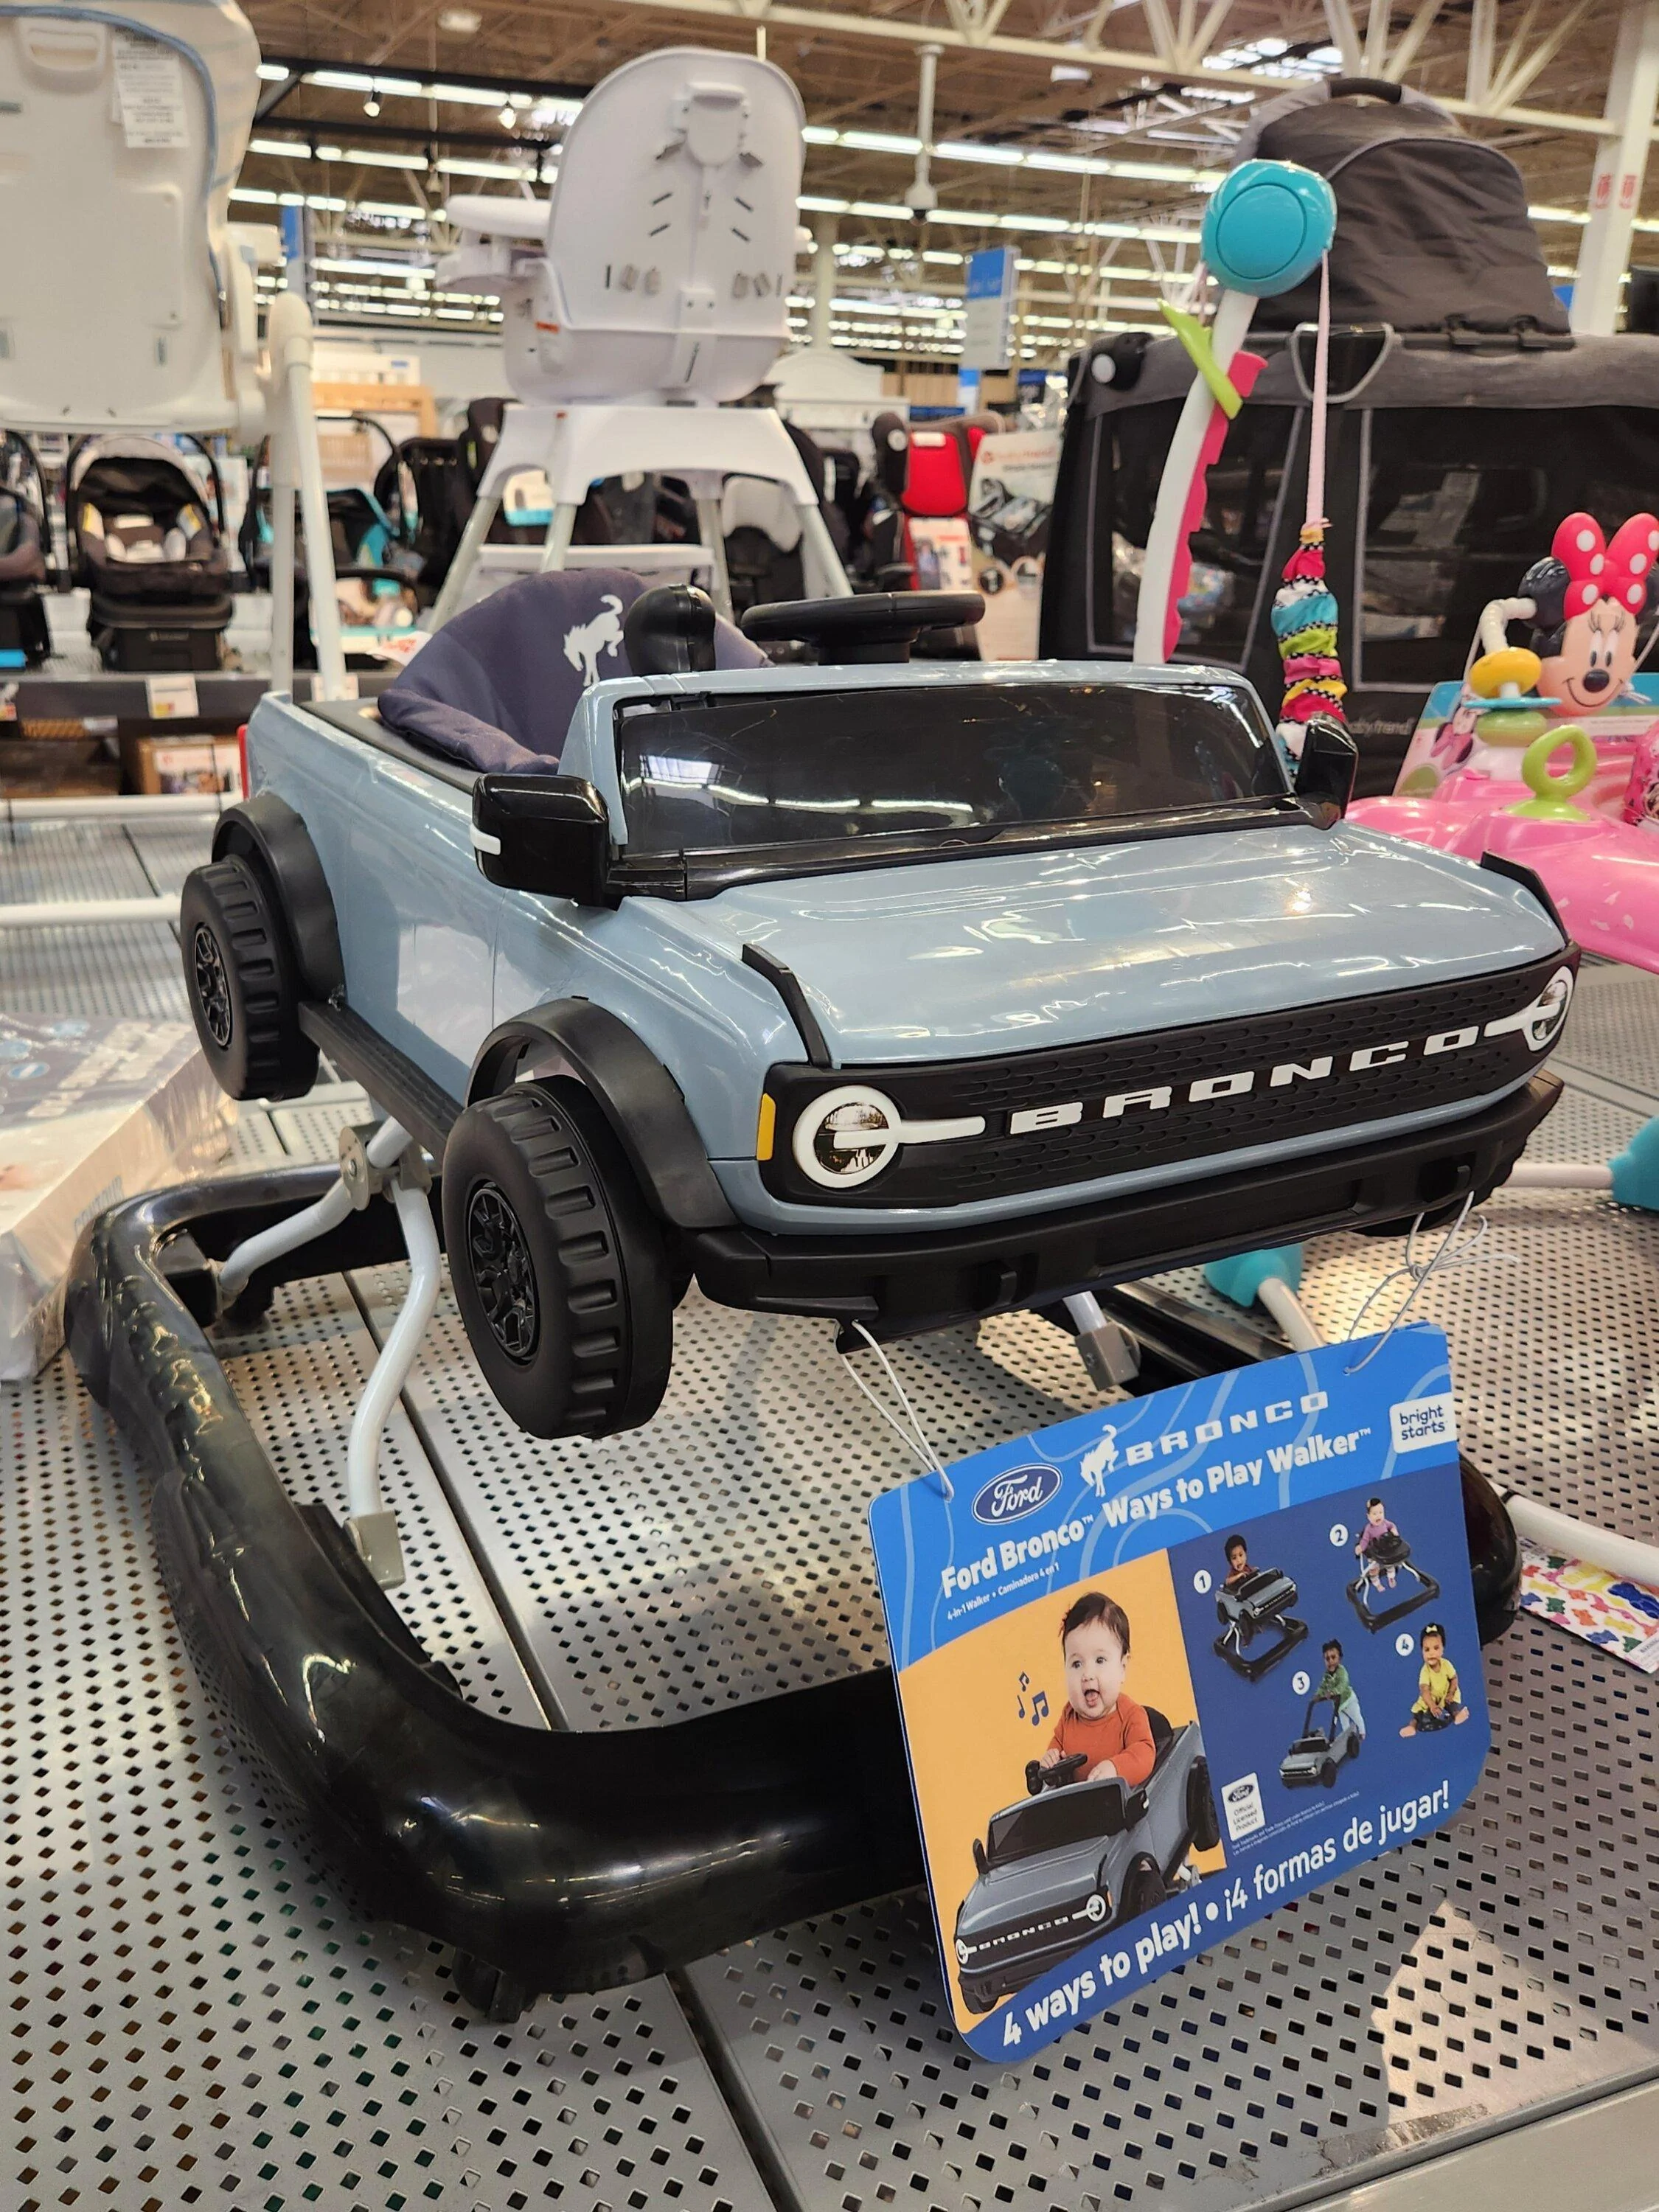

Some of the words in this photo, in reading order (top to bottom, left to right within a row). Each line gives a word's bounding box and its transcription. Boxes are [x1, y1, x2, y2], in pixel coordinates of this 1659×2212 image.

[1010, 1026, 1478, 1134] BRONCO
[1126, 1391, 1329, 1467] BRONCO
[1399, 1405, 1444, 1425] bright
[1402, 1421, 1445, 1440] starts
[942, 1547, 998, 1599] Ford
[1102, 1488, 1174, 1528] Ways
[1175, 1478, 1204, 1503] to
[1206, 1458, 1263, 1494] Play
[966, 1593, 990, 1611] Walker
[998, 1572, 1040, 1596] Caminadora
[1003, 2011, 1022, 2046] 4
[1025, 1971, 1096, 2031] ways
[1099, 1951, 1131, 1986] to
[1135, 1902, 1202, 1974] play!
[1253, 1837, 1336, 1900] formas
[1343, 1817, 1374, 1853] de
[1378, 1779, 1450, 1845] jugar!
